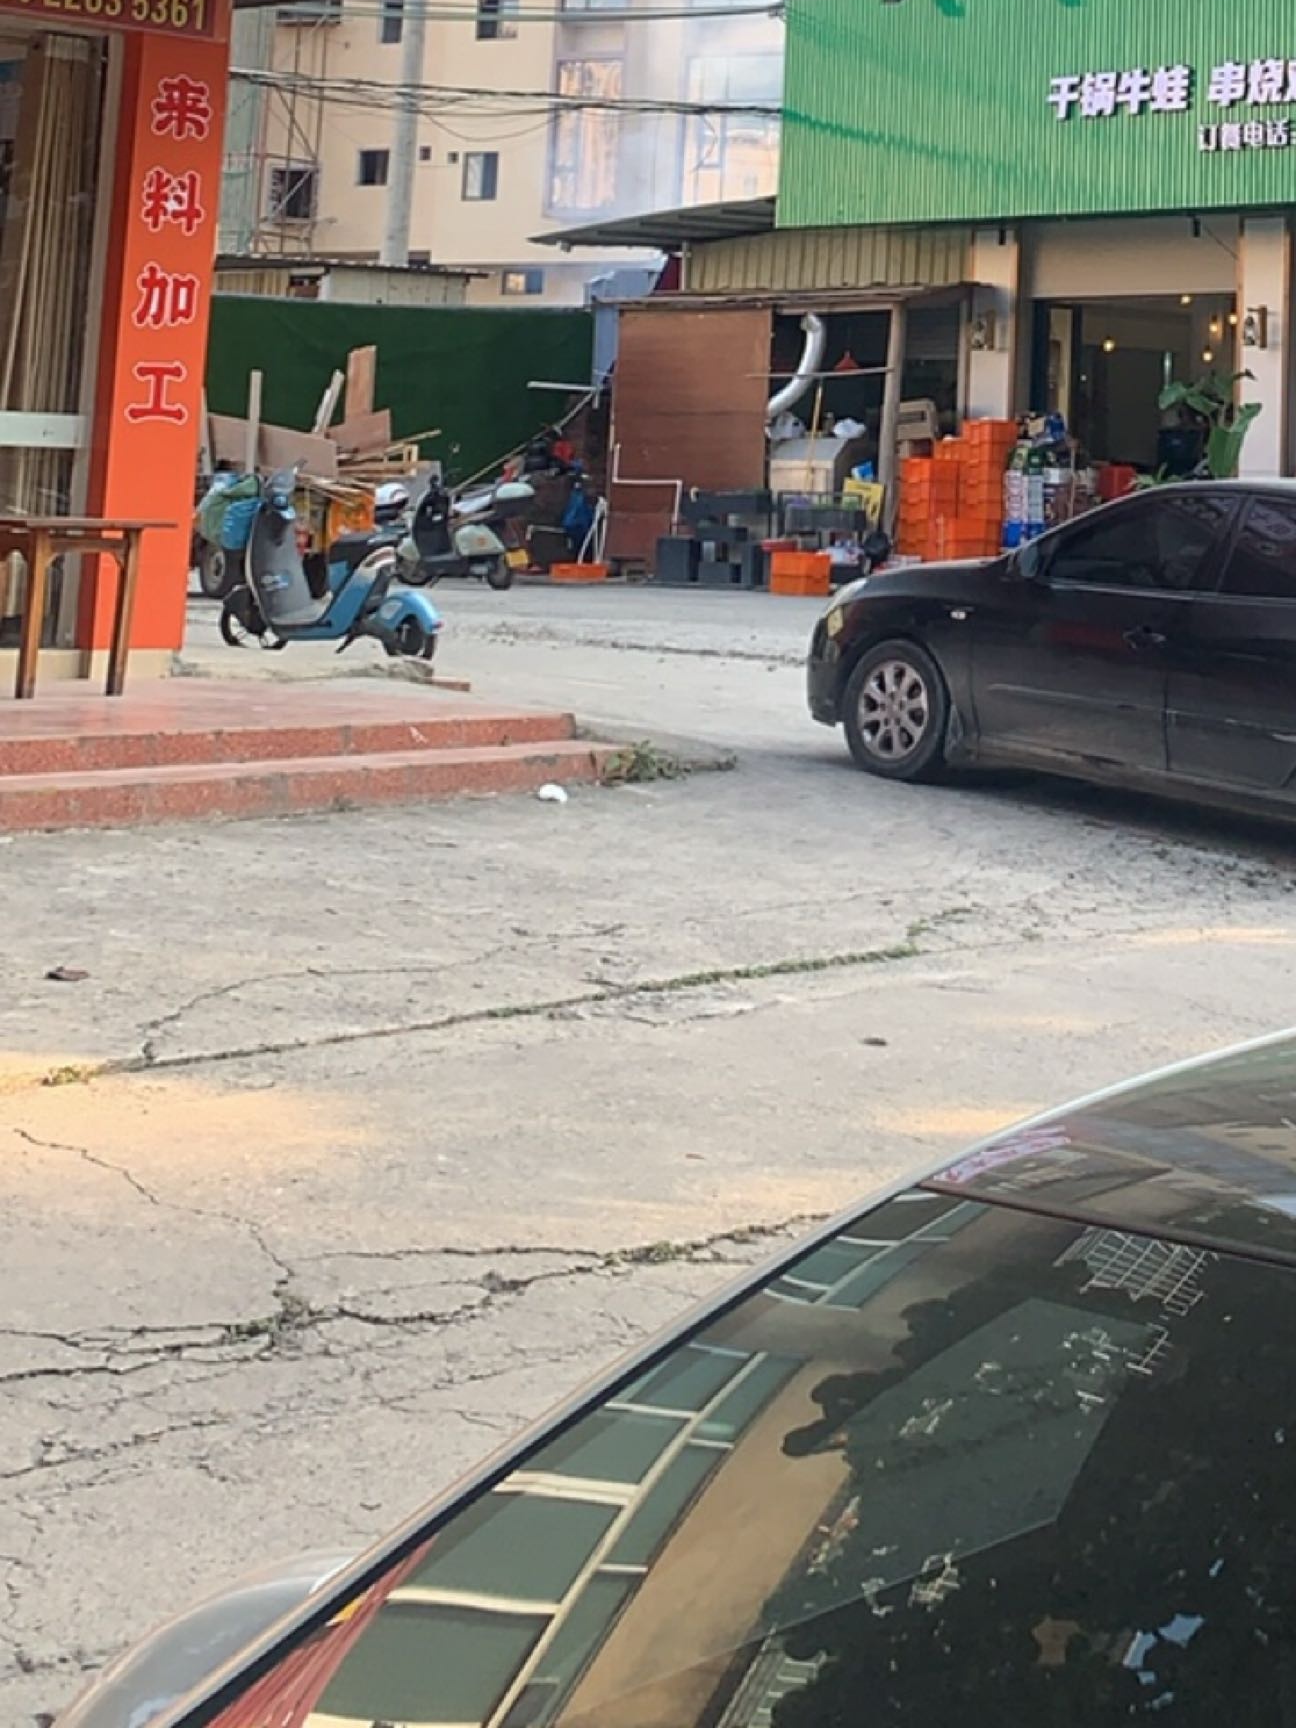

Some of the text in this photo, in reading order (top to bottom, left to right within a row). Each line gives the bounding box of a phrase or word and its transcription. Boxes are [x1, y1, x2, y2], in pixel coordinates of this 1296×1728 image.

[1047, 64, 1191, 120] 干锅牛蛙
[126, 75, 210, 424] 来料加工
